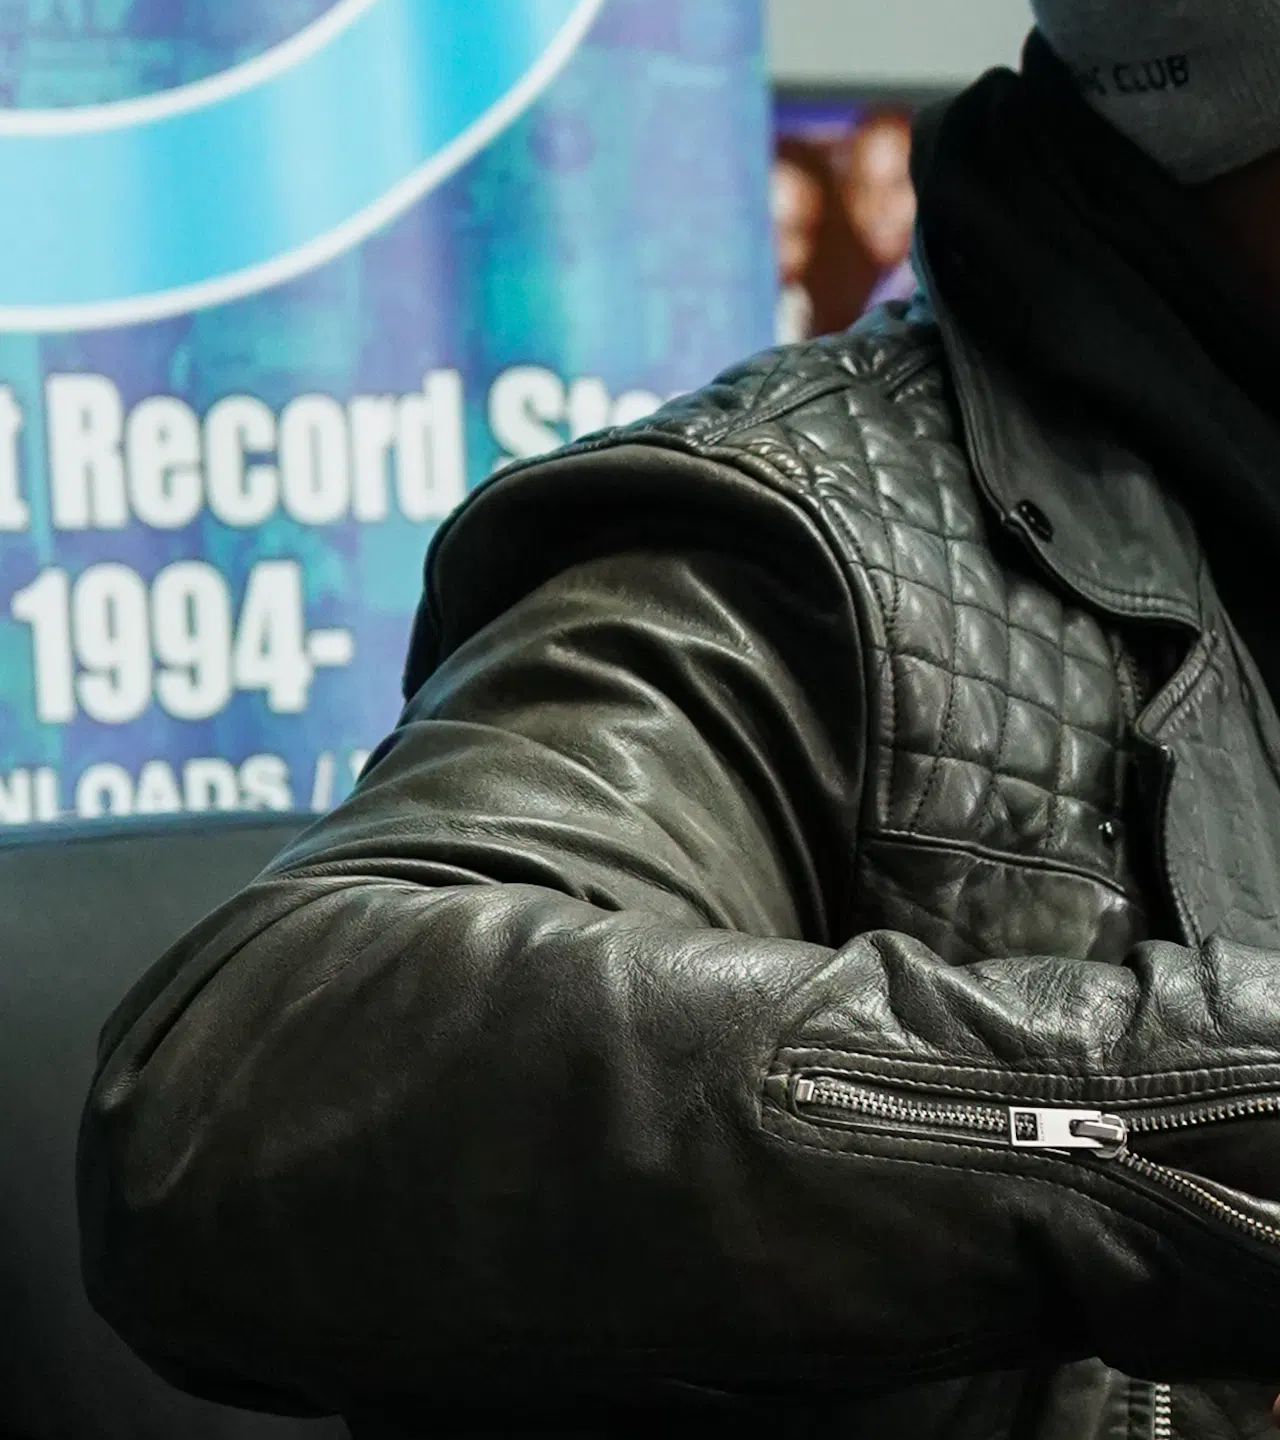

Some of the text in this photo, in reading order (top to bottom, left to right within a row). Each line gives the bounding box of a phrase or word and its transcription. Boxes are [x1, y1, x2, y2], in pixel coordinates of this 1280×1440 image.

[1113, 54, 1189, 94] CLUB
[46, 368, 466, 530] Record
[12, 559, 353, 725] 1994-
